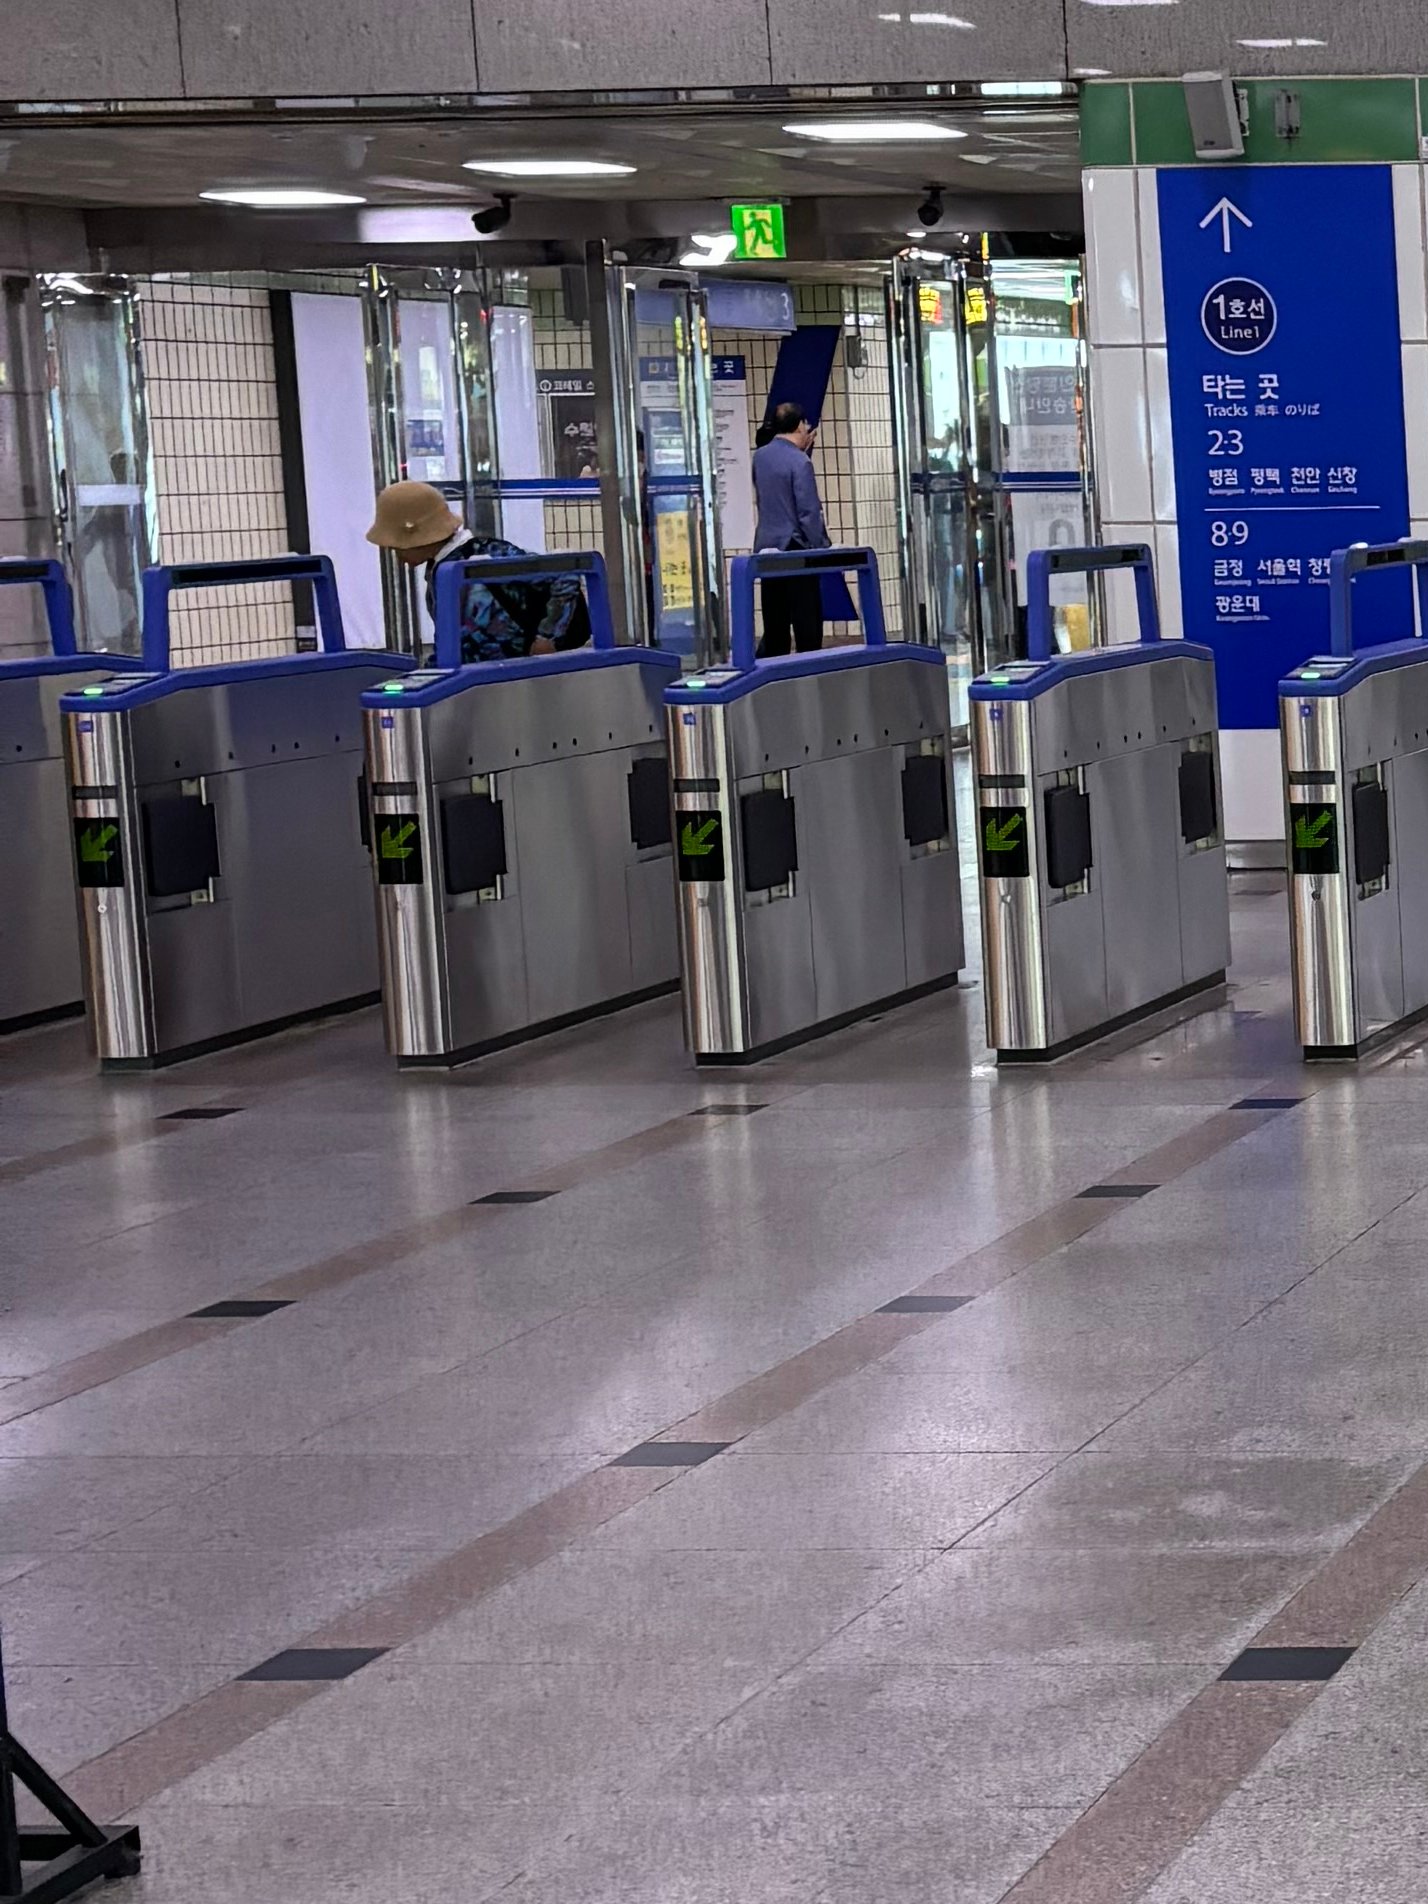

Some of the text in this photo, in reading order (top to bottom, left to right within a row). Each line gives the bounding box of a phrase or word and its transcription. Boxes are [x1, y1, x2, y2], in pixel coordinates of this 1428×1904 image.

[1212, 294, 1266, 320] 1호선
[1202, 373, 1280, 400] 타는 곳
[1204, 403, 1248, 417] Tracks
[1208, 466, 1358, 486] 병점 평택 천안 신창
[1214, 559, 1243, 577] 금정
[1257, 557, 1301, 576] 서울역
[1216, 595, 1260, 613] 광운대
